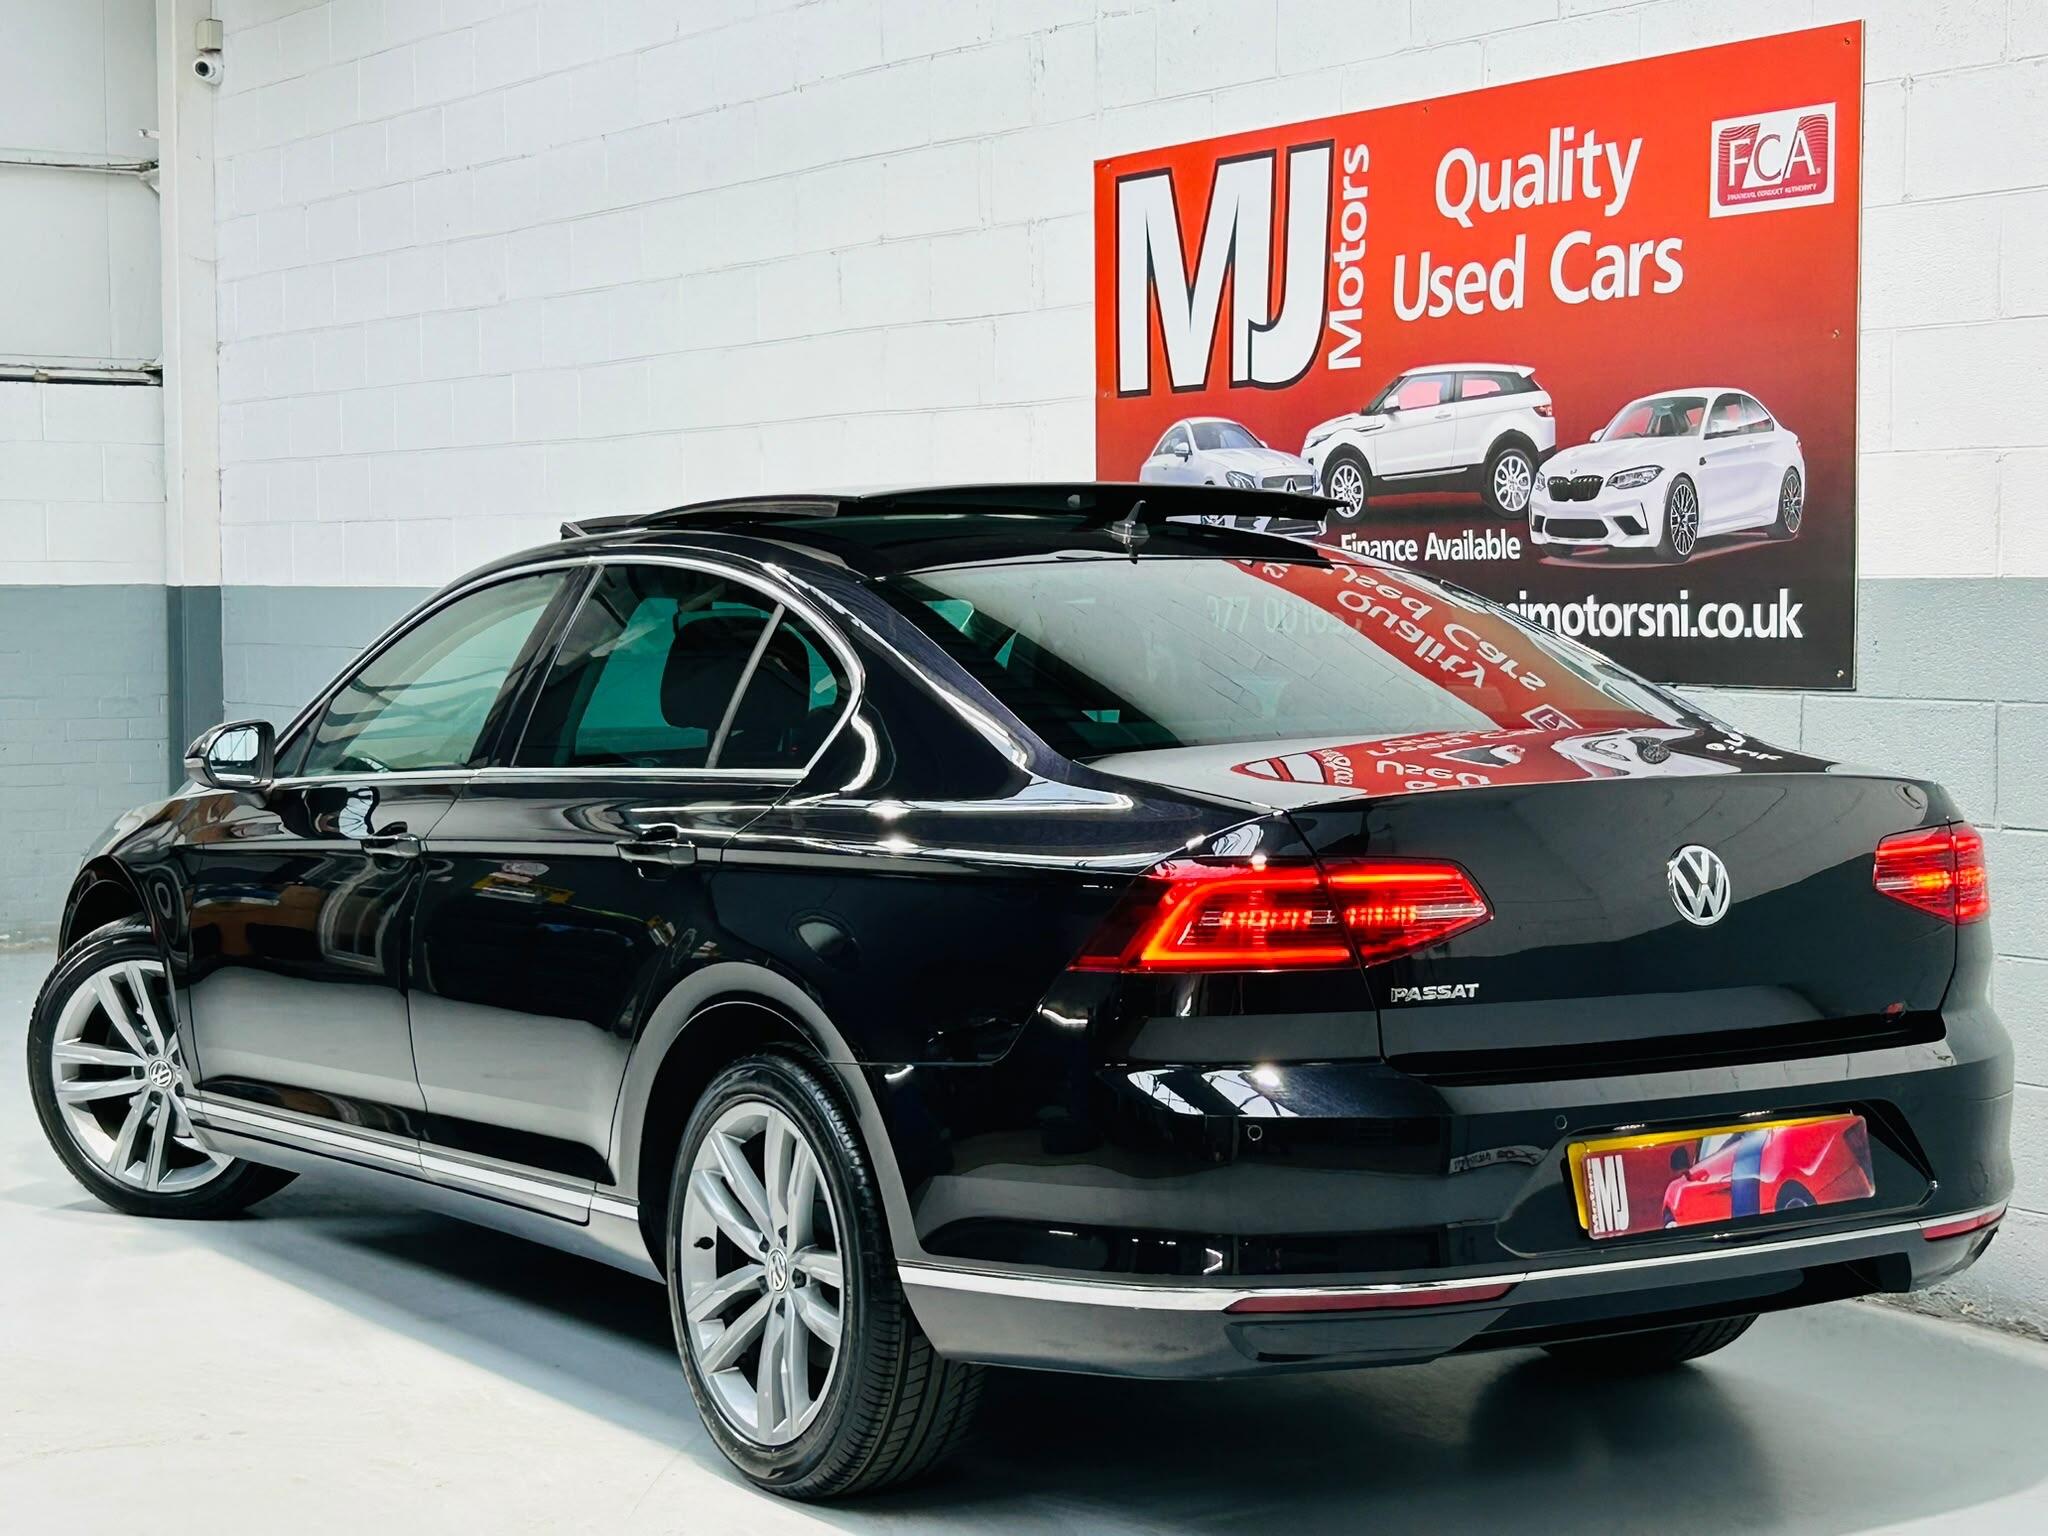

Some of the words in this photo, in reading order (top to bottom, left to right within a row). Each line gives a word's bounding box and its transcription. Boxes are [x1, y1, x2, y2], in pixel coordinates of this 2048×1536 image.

[1434, 127, 1644, 228] Quality
[1727, 128, 1818, 187] FCA
[1116, 138, 1336, 398] MJ
[1328, 142, 1371, 371] Motors
[1393, 234, 1526, 322] Used
[1549, 230, 1684, 304] Cars
[1340, 532, 1419, 561] Finance
[1424, 528, 1521, 562] Available
[1390, 983, 1480, 1003] PASSAT
[1590, 1154, 1630, 1233] MJ
